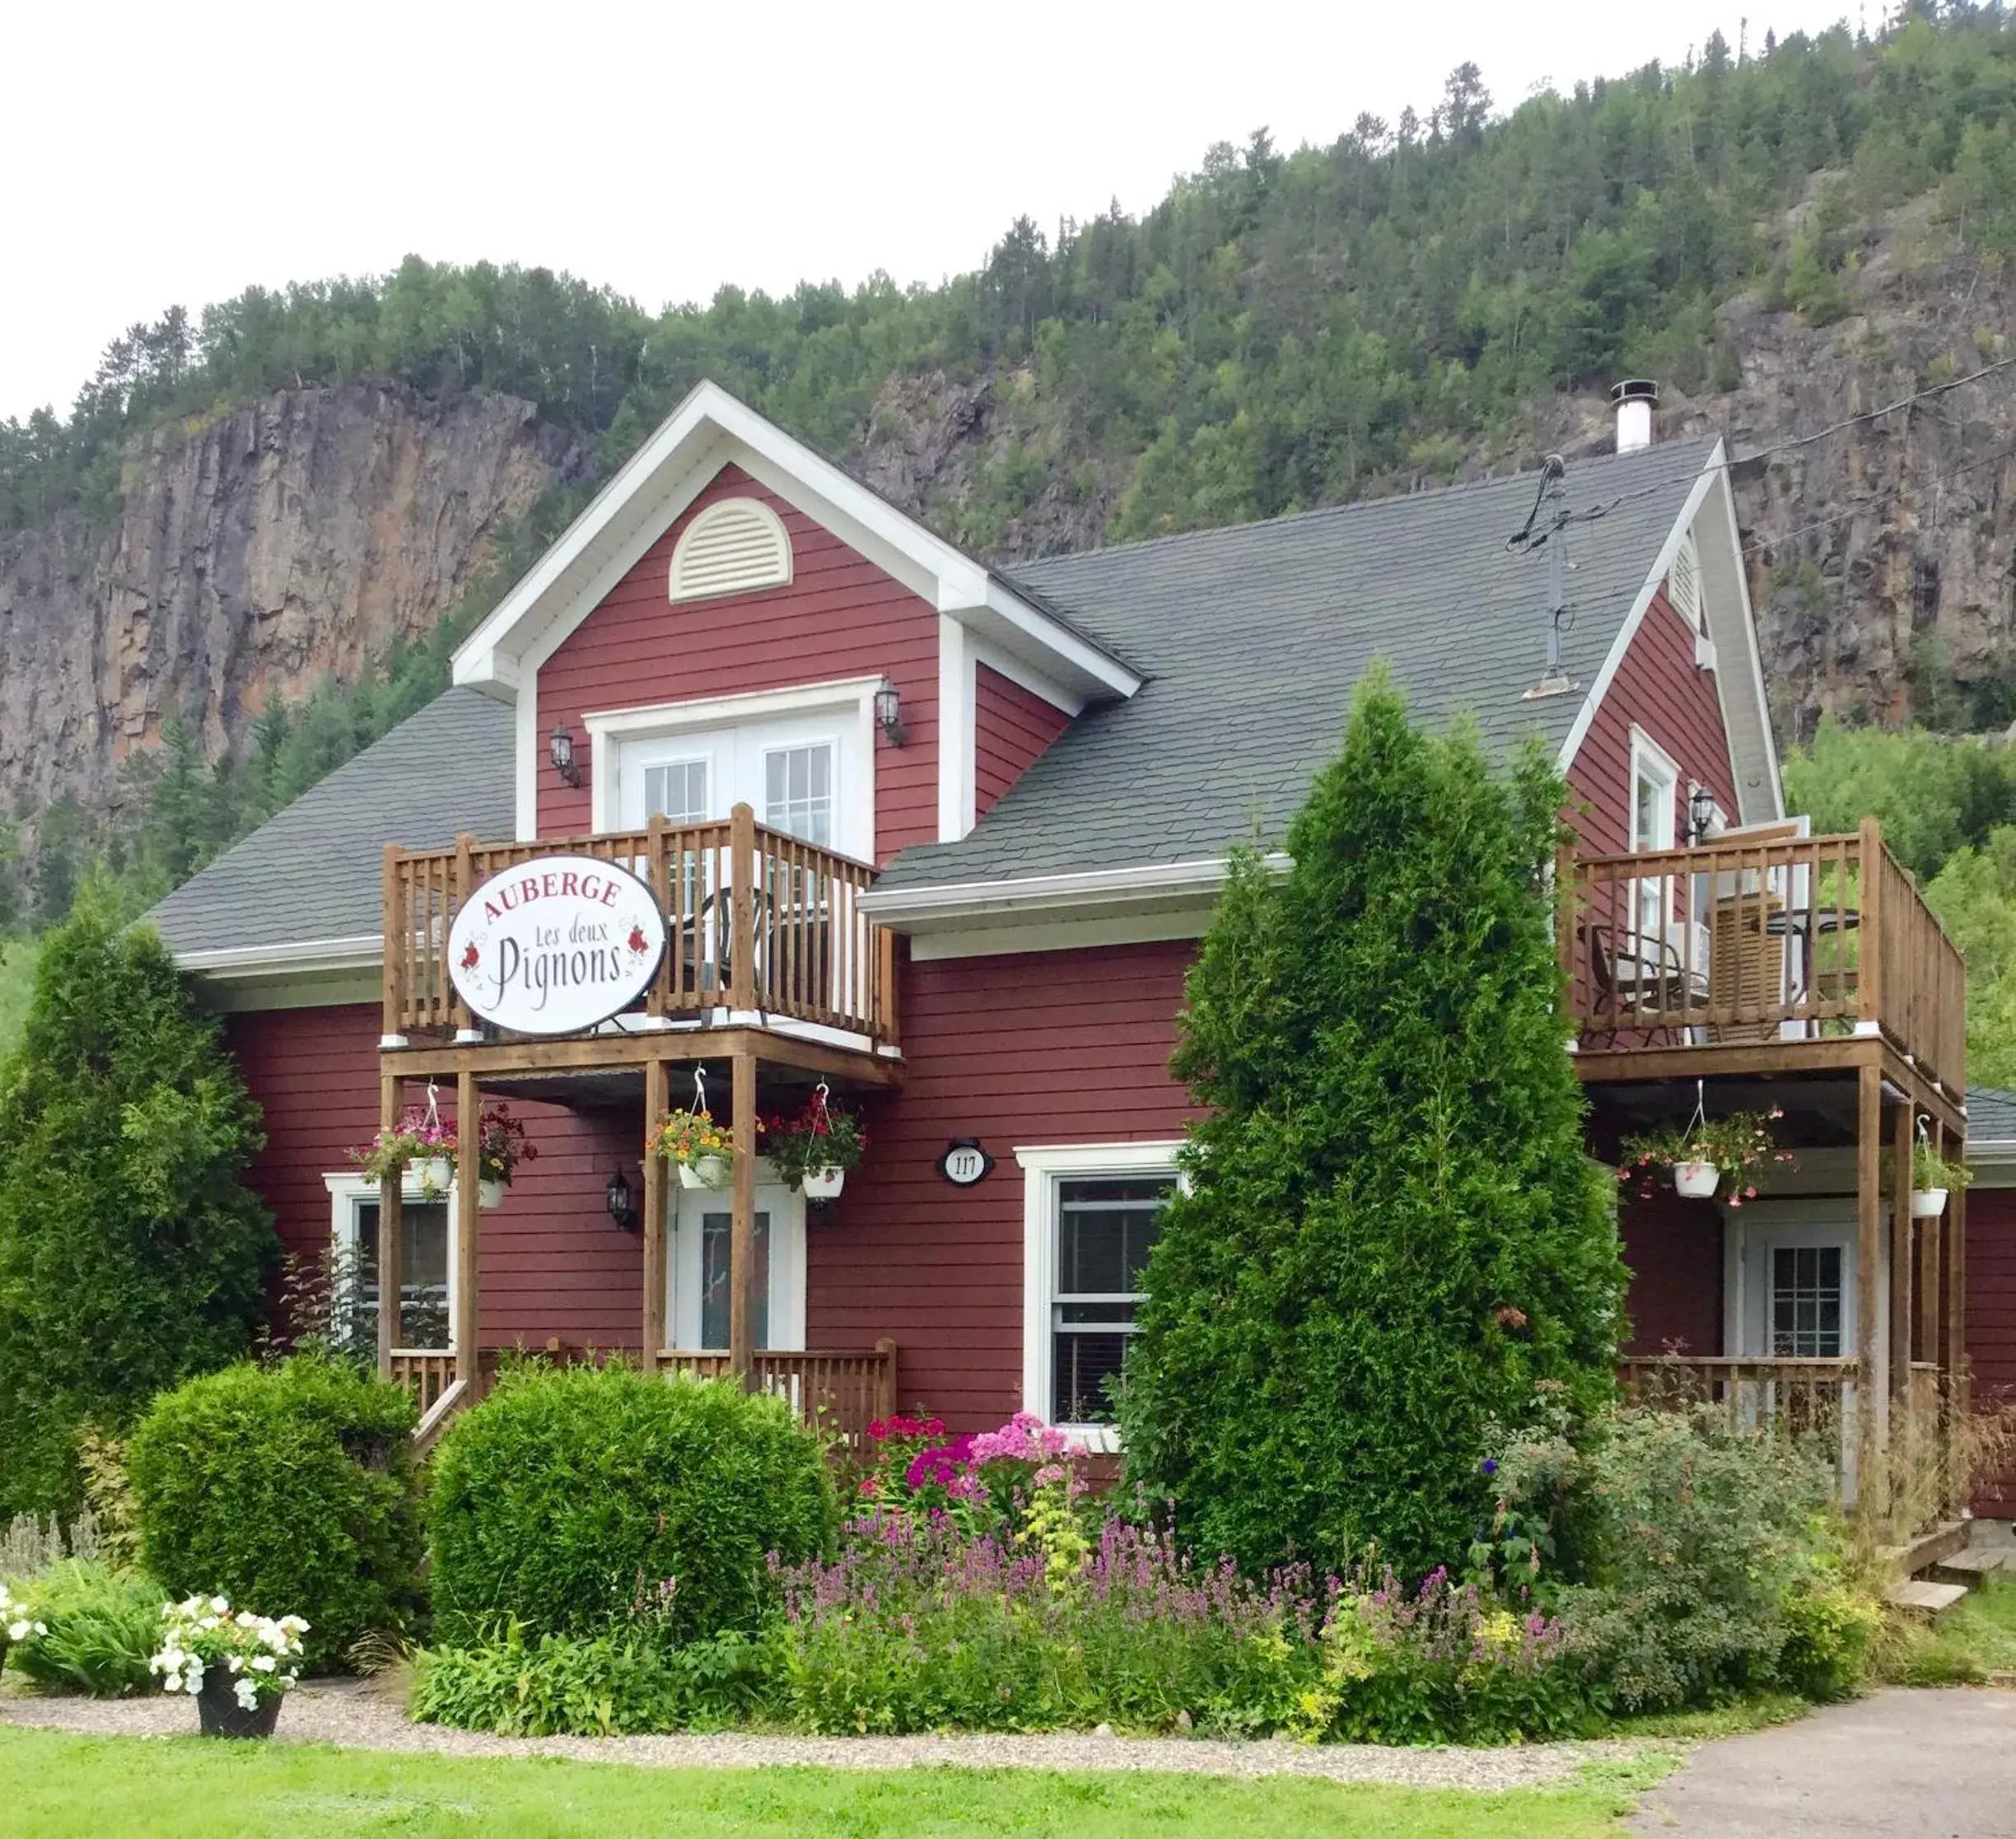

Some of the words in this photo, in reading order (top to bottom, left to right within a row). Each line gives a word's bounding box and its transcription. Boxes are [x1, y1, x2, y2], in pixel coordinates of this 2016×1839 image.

[483, 871, 623, 926] AUBERGE
[536, 923, 561, 948] Les
[568, 912, 609, 945] deux
[480, 936, 621, 1012] Pignons
[955, 1155, 976, 1175] 117
